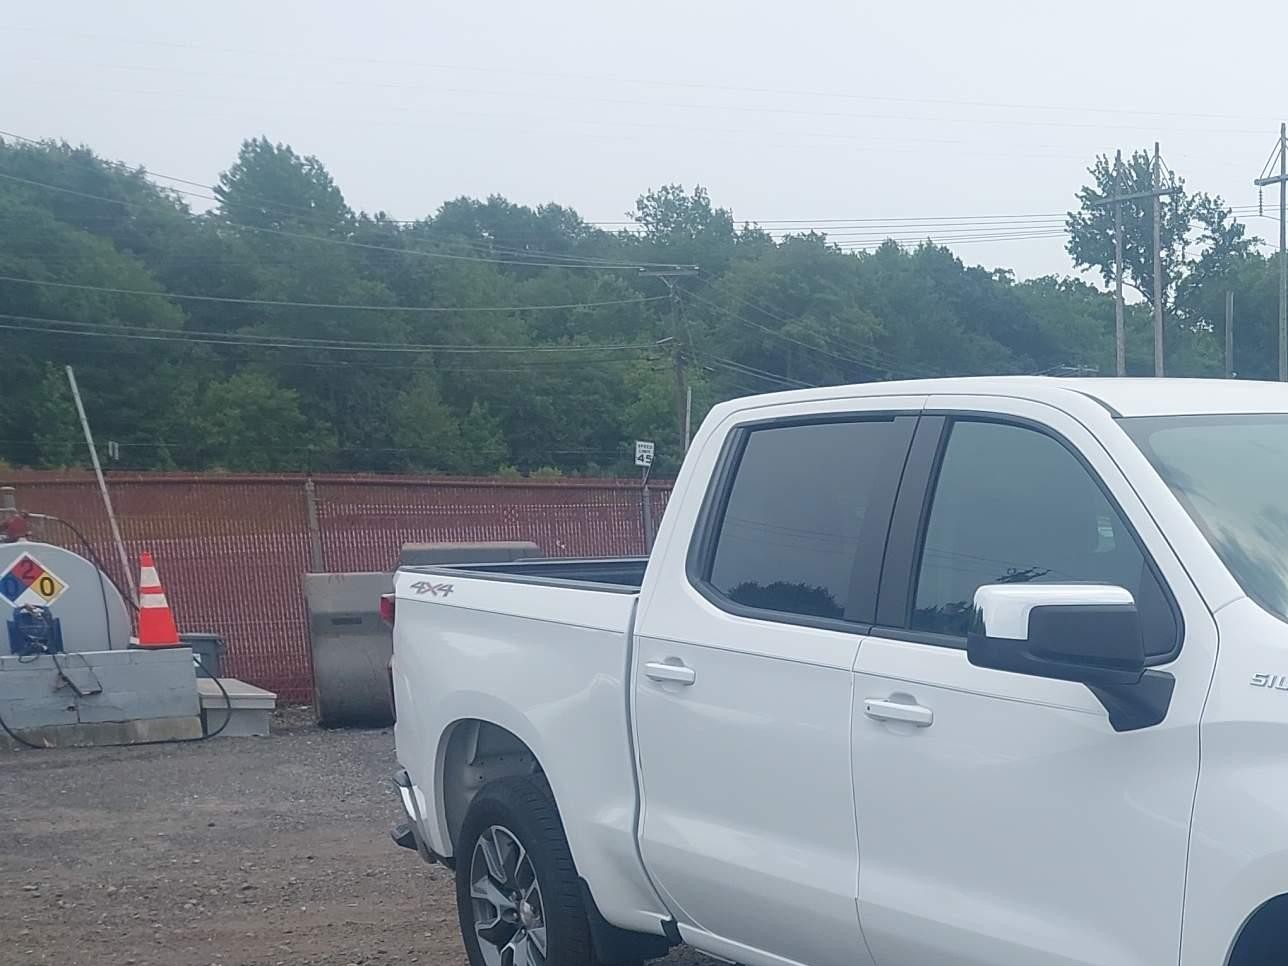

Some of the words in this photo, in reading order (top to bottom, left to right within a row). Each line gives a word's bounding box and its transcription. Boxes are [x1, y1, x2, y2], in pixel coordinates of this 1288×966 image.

[637, 454, 652, 464] 45
[20, 560, 35, 580] 2
[40, 576, 55, 597] 0
